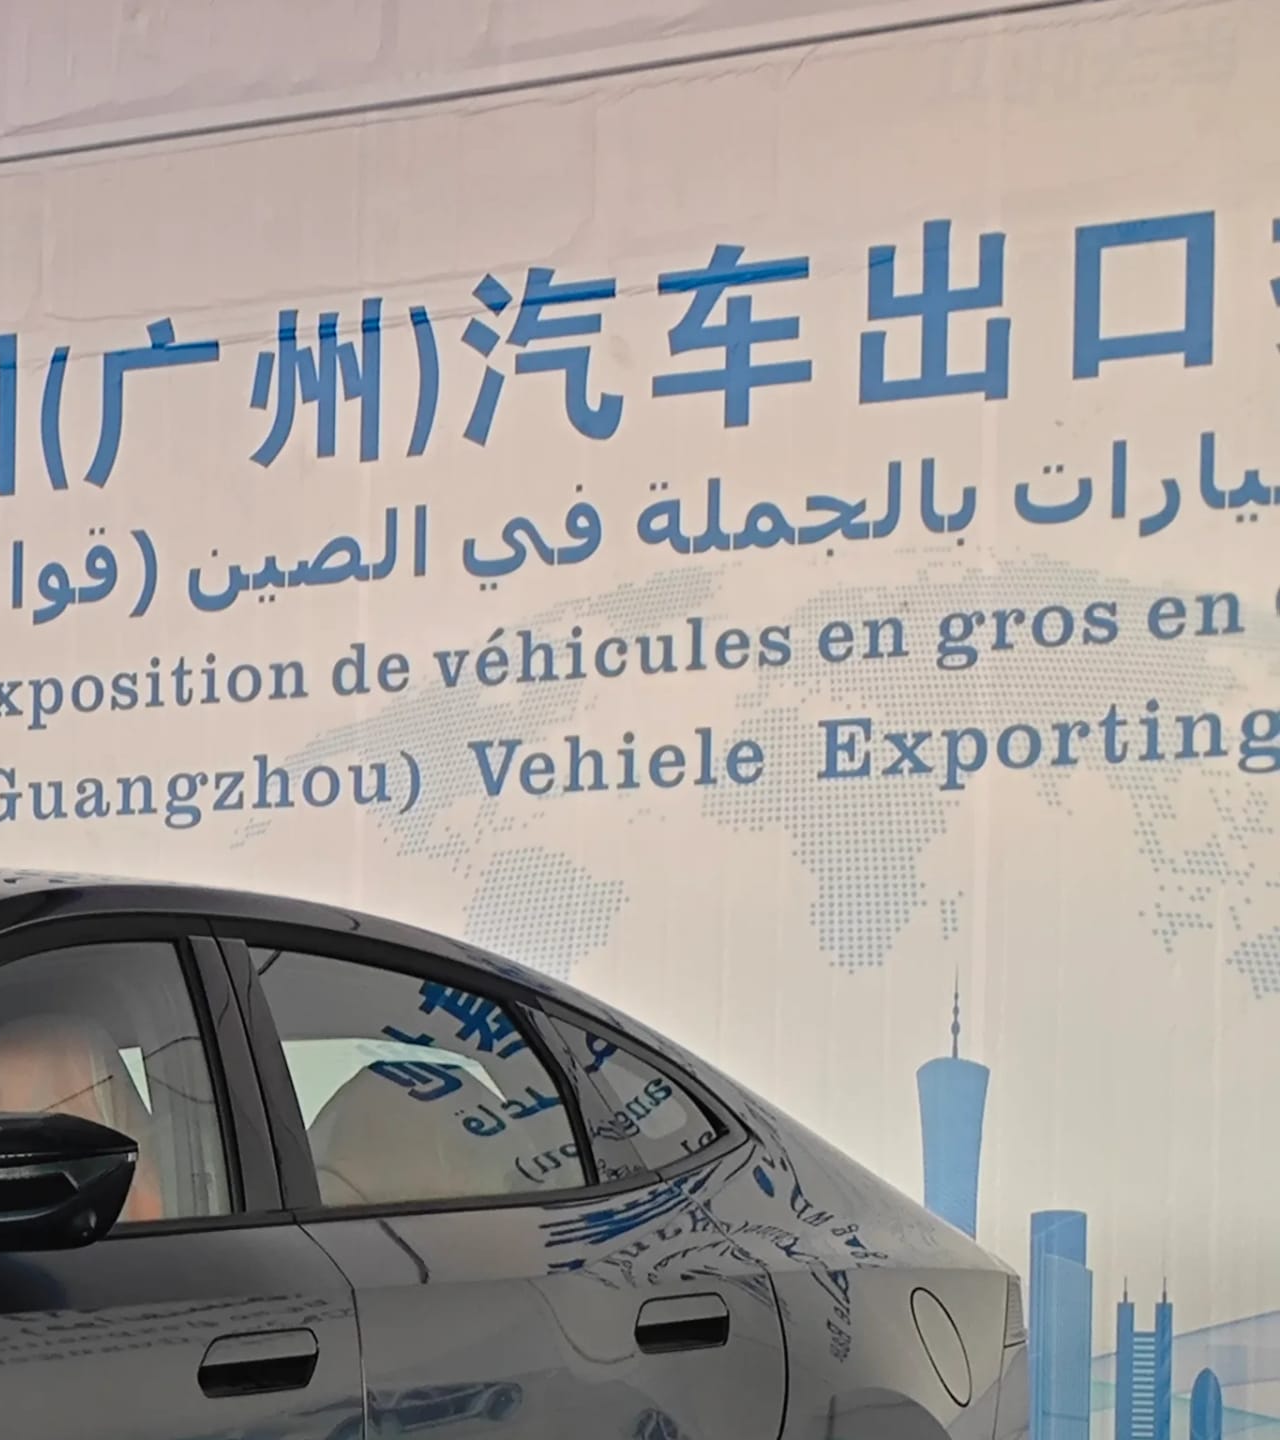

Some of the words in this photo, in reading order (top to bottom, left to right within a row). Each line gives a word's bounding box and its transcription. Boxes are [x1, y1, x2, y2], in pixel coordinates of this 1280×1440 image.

[461, 483, 603, 592] في
[635, 456, 978, 558] بالجملة
[1013, 430, 1280, 538] يارات
[187, 503, 428, 613] الصين
[331, 641, 411, 697] de
[431, 615, 793, 690] véhicules
[817, 616, 911, 665] en
[935, 600, 1121, 672] gros
[1146, 591, 1246, 642] en
[466, 726, 766, 798] Vehiele
[815, 697, 1280, 793] Exporting
